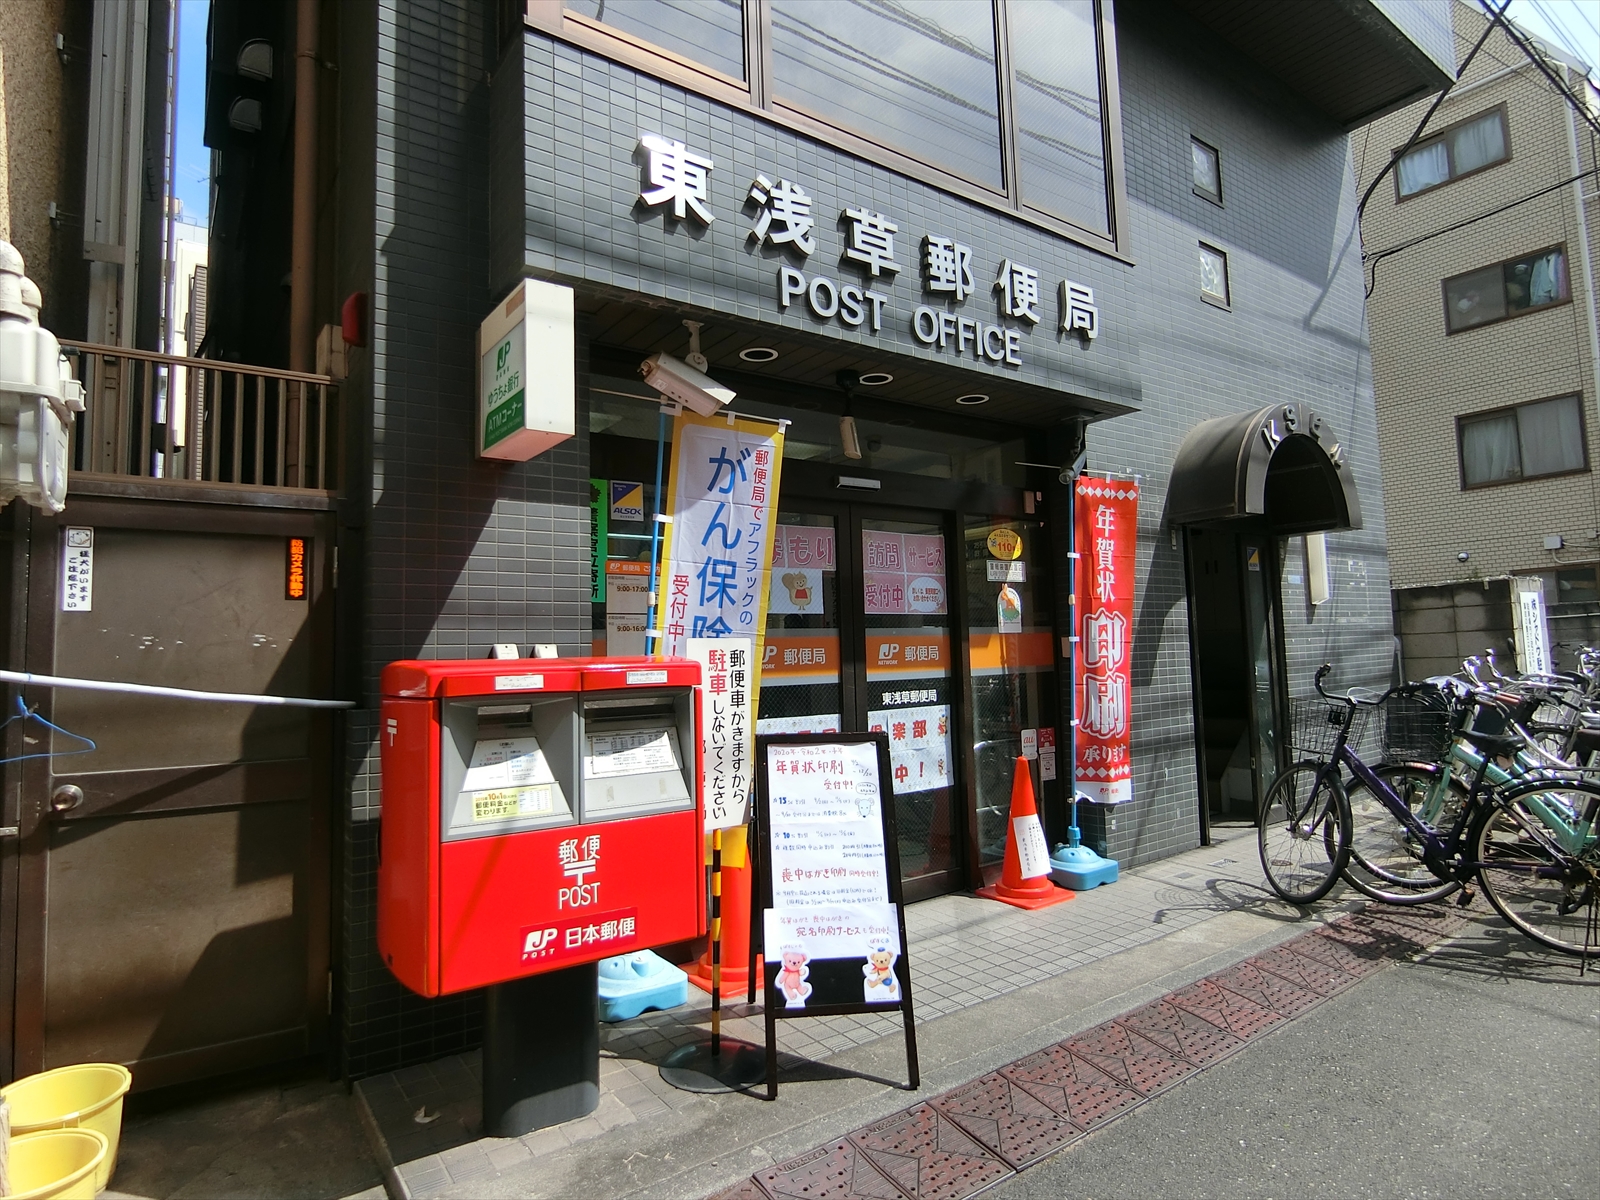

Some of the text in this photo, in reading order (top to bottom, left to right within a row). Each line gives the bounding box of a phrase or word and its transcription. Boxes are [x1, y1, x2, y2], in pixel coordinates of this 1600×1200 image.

[640, 135, 1099, 339] 東浅草郵便局
[779, 267, 1023, 365] POST OFFICE
[488, 371, 519, 407] ゆうちょ銀行
[488, 402, 522, 432] ATMコーナー
[613, 507, 642, 515] ALSOK
[739, 449, 770, 626] 郵便局でアフラックの
[868, 541, 943, 569] 訪問 サービス
[67, 556, 78, 608] ご注意下さい
[616, 585, 648, 593] 9:00-17:00
[865, 584, 904, 608] 受付中
[1082, 504, 1127, 763] 年賀状 印刷 承ります
[784, 648, 825, 665] 郵便局
[904, 646, 939, 661] 郵便局
[881, 689, 937, 705] 東浅草郵便局
[708, 649, 728, 819] 駐車 しないでください
[729, 649, 746, 804] 郵便車がきますから
[776, 760, 844, 775] 年賀状印刷
[475, 799, 517, 809] 郵便料金などが
[558, 835, 600, 865] 郵便
[558, 882, 600, 910] POST
[566, 917, 635, 949] 日本郵便
[522, 948, 555, 960] POST
